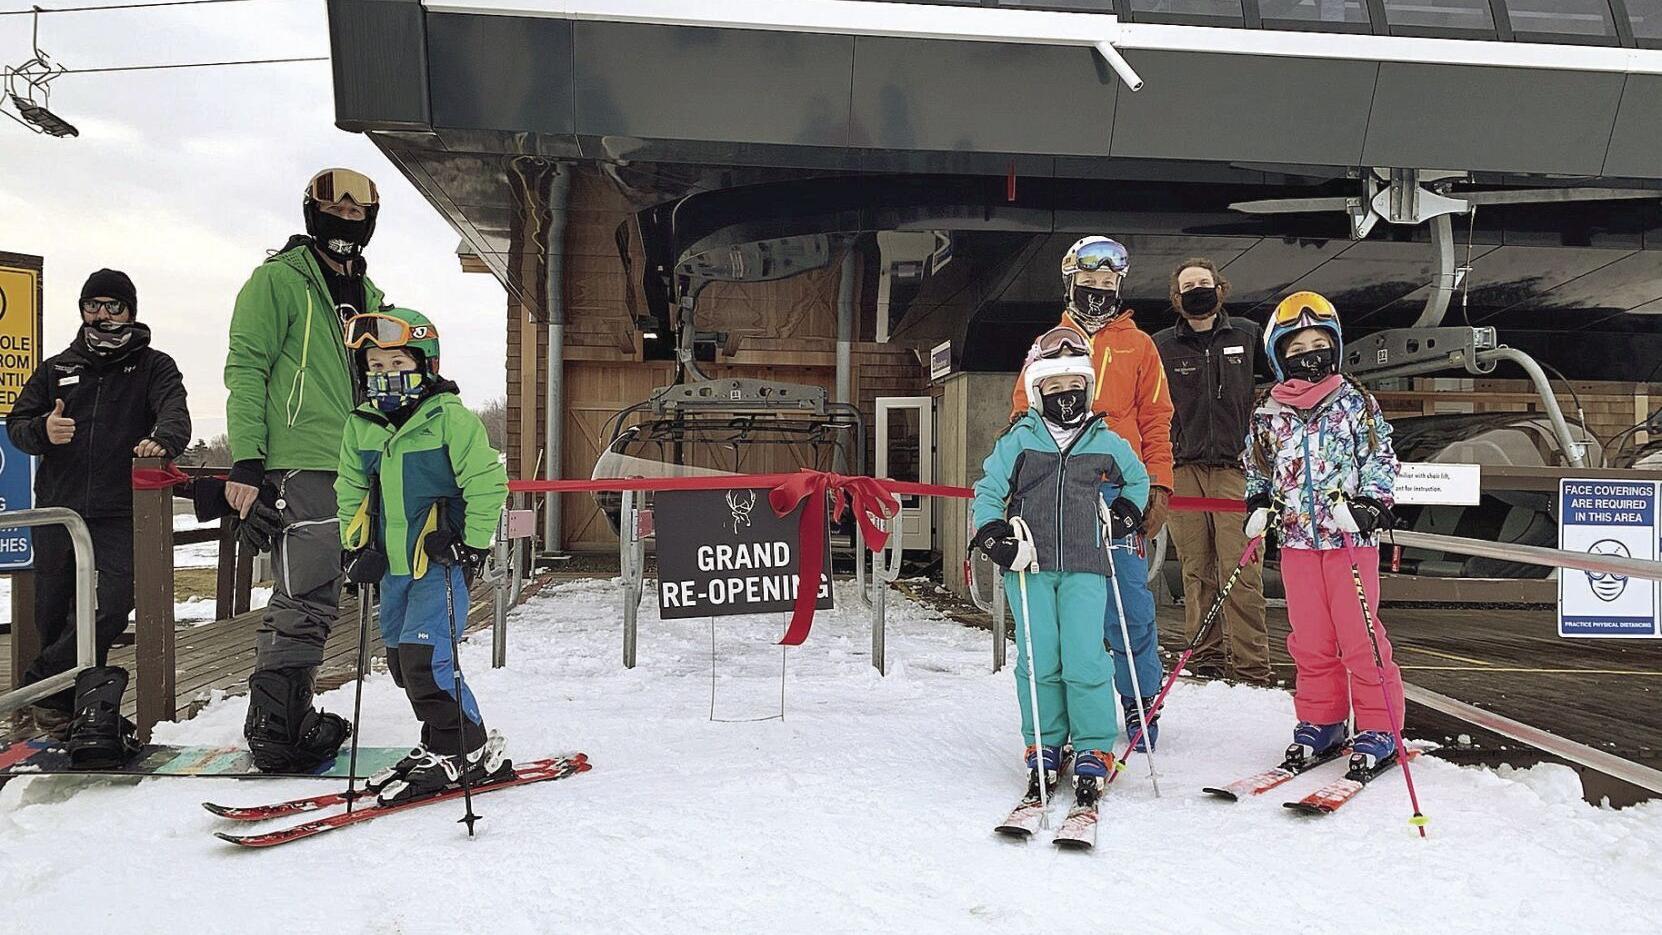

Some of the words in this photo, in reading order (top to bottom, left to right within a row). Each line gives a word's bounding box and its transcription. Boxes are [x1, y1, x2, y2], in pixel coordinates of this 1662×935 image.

[0, 335, 30, 351] OLE
[1565, 485, 1592, 495] FACE
[1594, 486, 1653, 496] COVERINGS
[1571, 499, 1593, 508] ARE
[1595, 499, 1647, 509] REQUIRED
[1575, 512, 1586, 521] IN
[1588, 512, 1612, 522] THIS
[1614, 513, 1643, 522] AREA
[697, 541, 790, 571] GRAND
